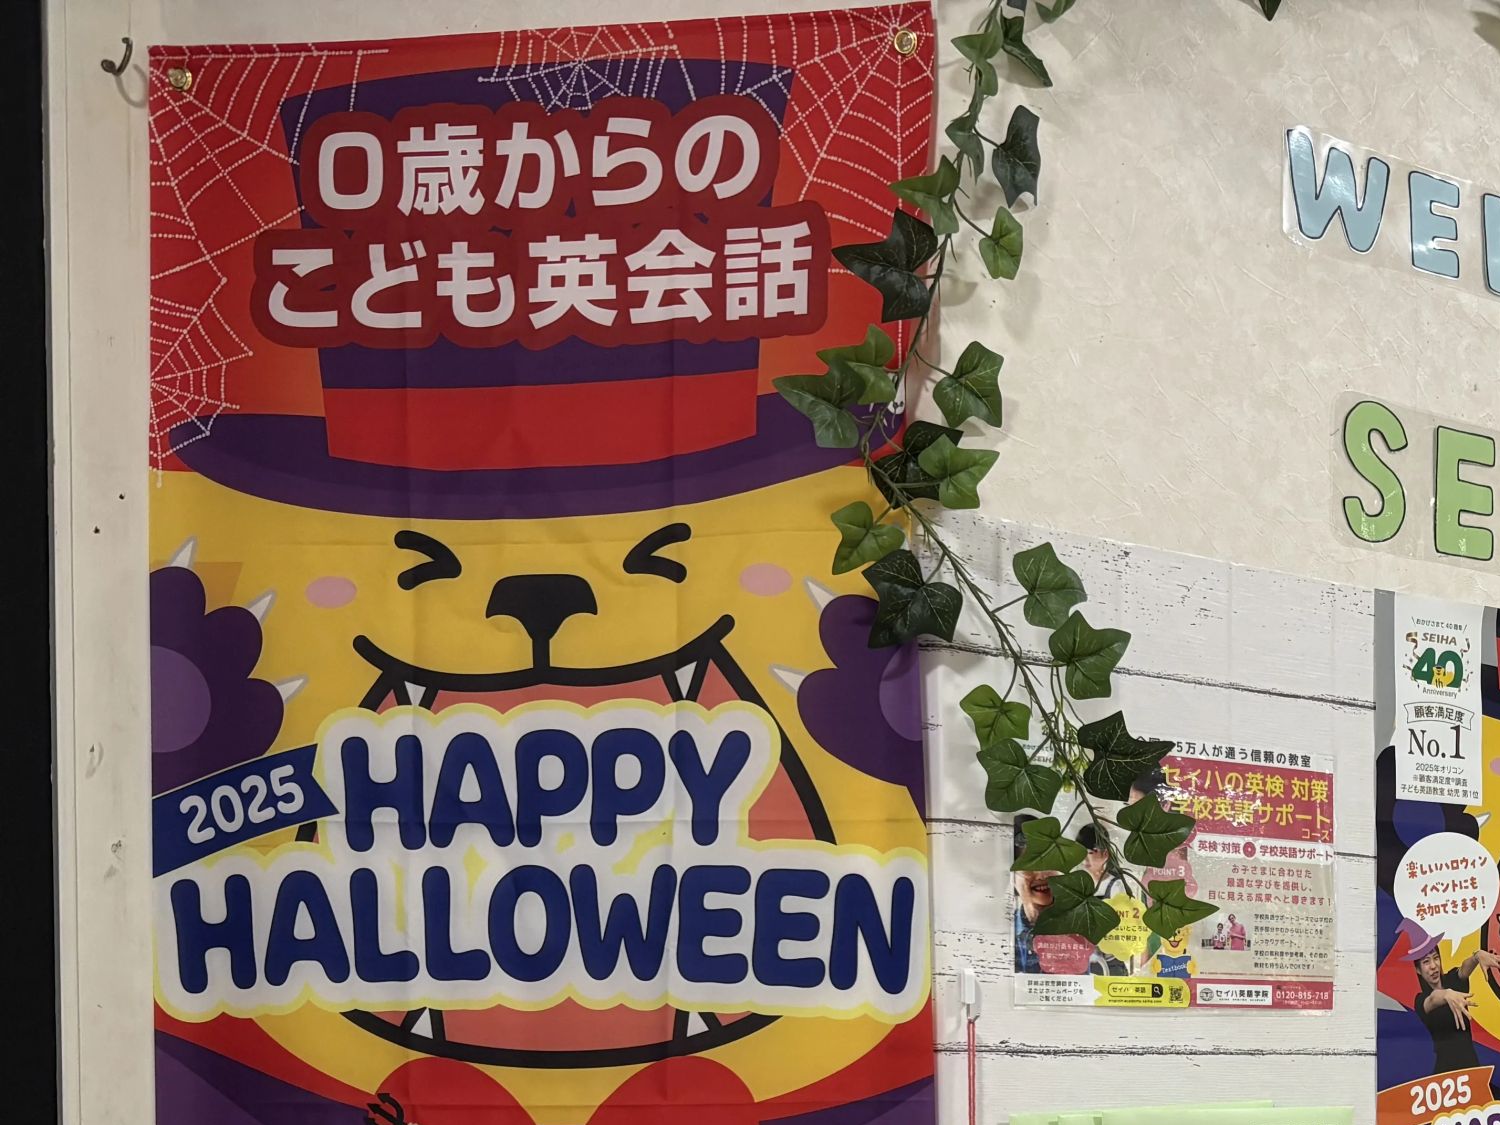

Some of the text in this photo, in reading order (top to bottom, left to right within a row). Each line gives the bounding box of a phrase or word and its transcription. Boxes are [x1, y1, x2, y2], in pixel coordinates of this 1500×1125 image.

[318, 116, 760, 217] 0歳からの
[267, 222, 814, 329] こども英会話
[1421, 632, 1458, 646] SEIHA
[1422, 686, 1458, 699] Anniversary
[1414, 705, 1465, 724] 顧客満足度
[1407, 724, 1466, 760] No.1
[1415, 762, 1464, 775] 2025年オリコン
[340, 727, 752, 853] HAPPY
[1400, 783, 1446, 797] 子ども英語教室
[1447, 787, 1461, 798] 幼児
[178, 765, 305, 847] 2025
[1171, 796, 1331, 829] 学校英語サポート
[1301, 828, 1330, 841] コース
[1259, 845, 1333, 861] 学校英語サポート
[1178, 866, 1186, 878] 3
[1231, 864, 1313, 879] お子さまに合わせた
[1405, 854, 1488, 879] 楽しいハロウィン
[1419, 876, 1478, 897] イベントにも
[1415, 897, 1487, 922] 参加できます!
[169, 863, 917, 996] HALLOWEEN
[1276, 991, 1329, 1000] 0120-815-718
[1409, 1075, 1472, 1116] 2025
